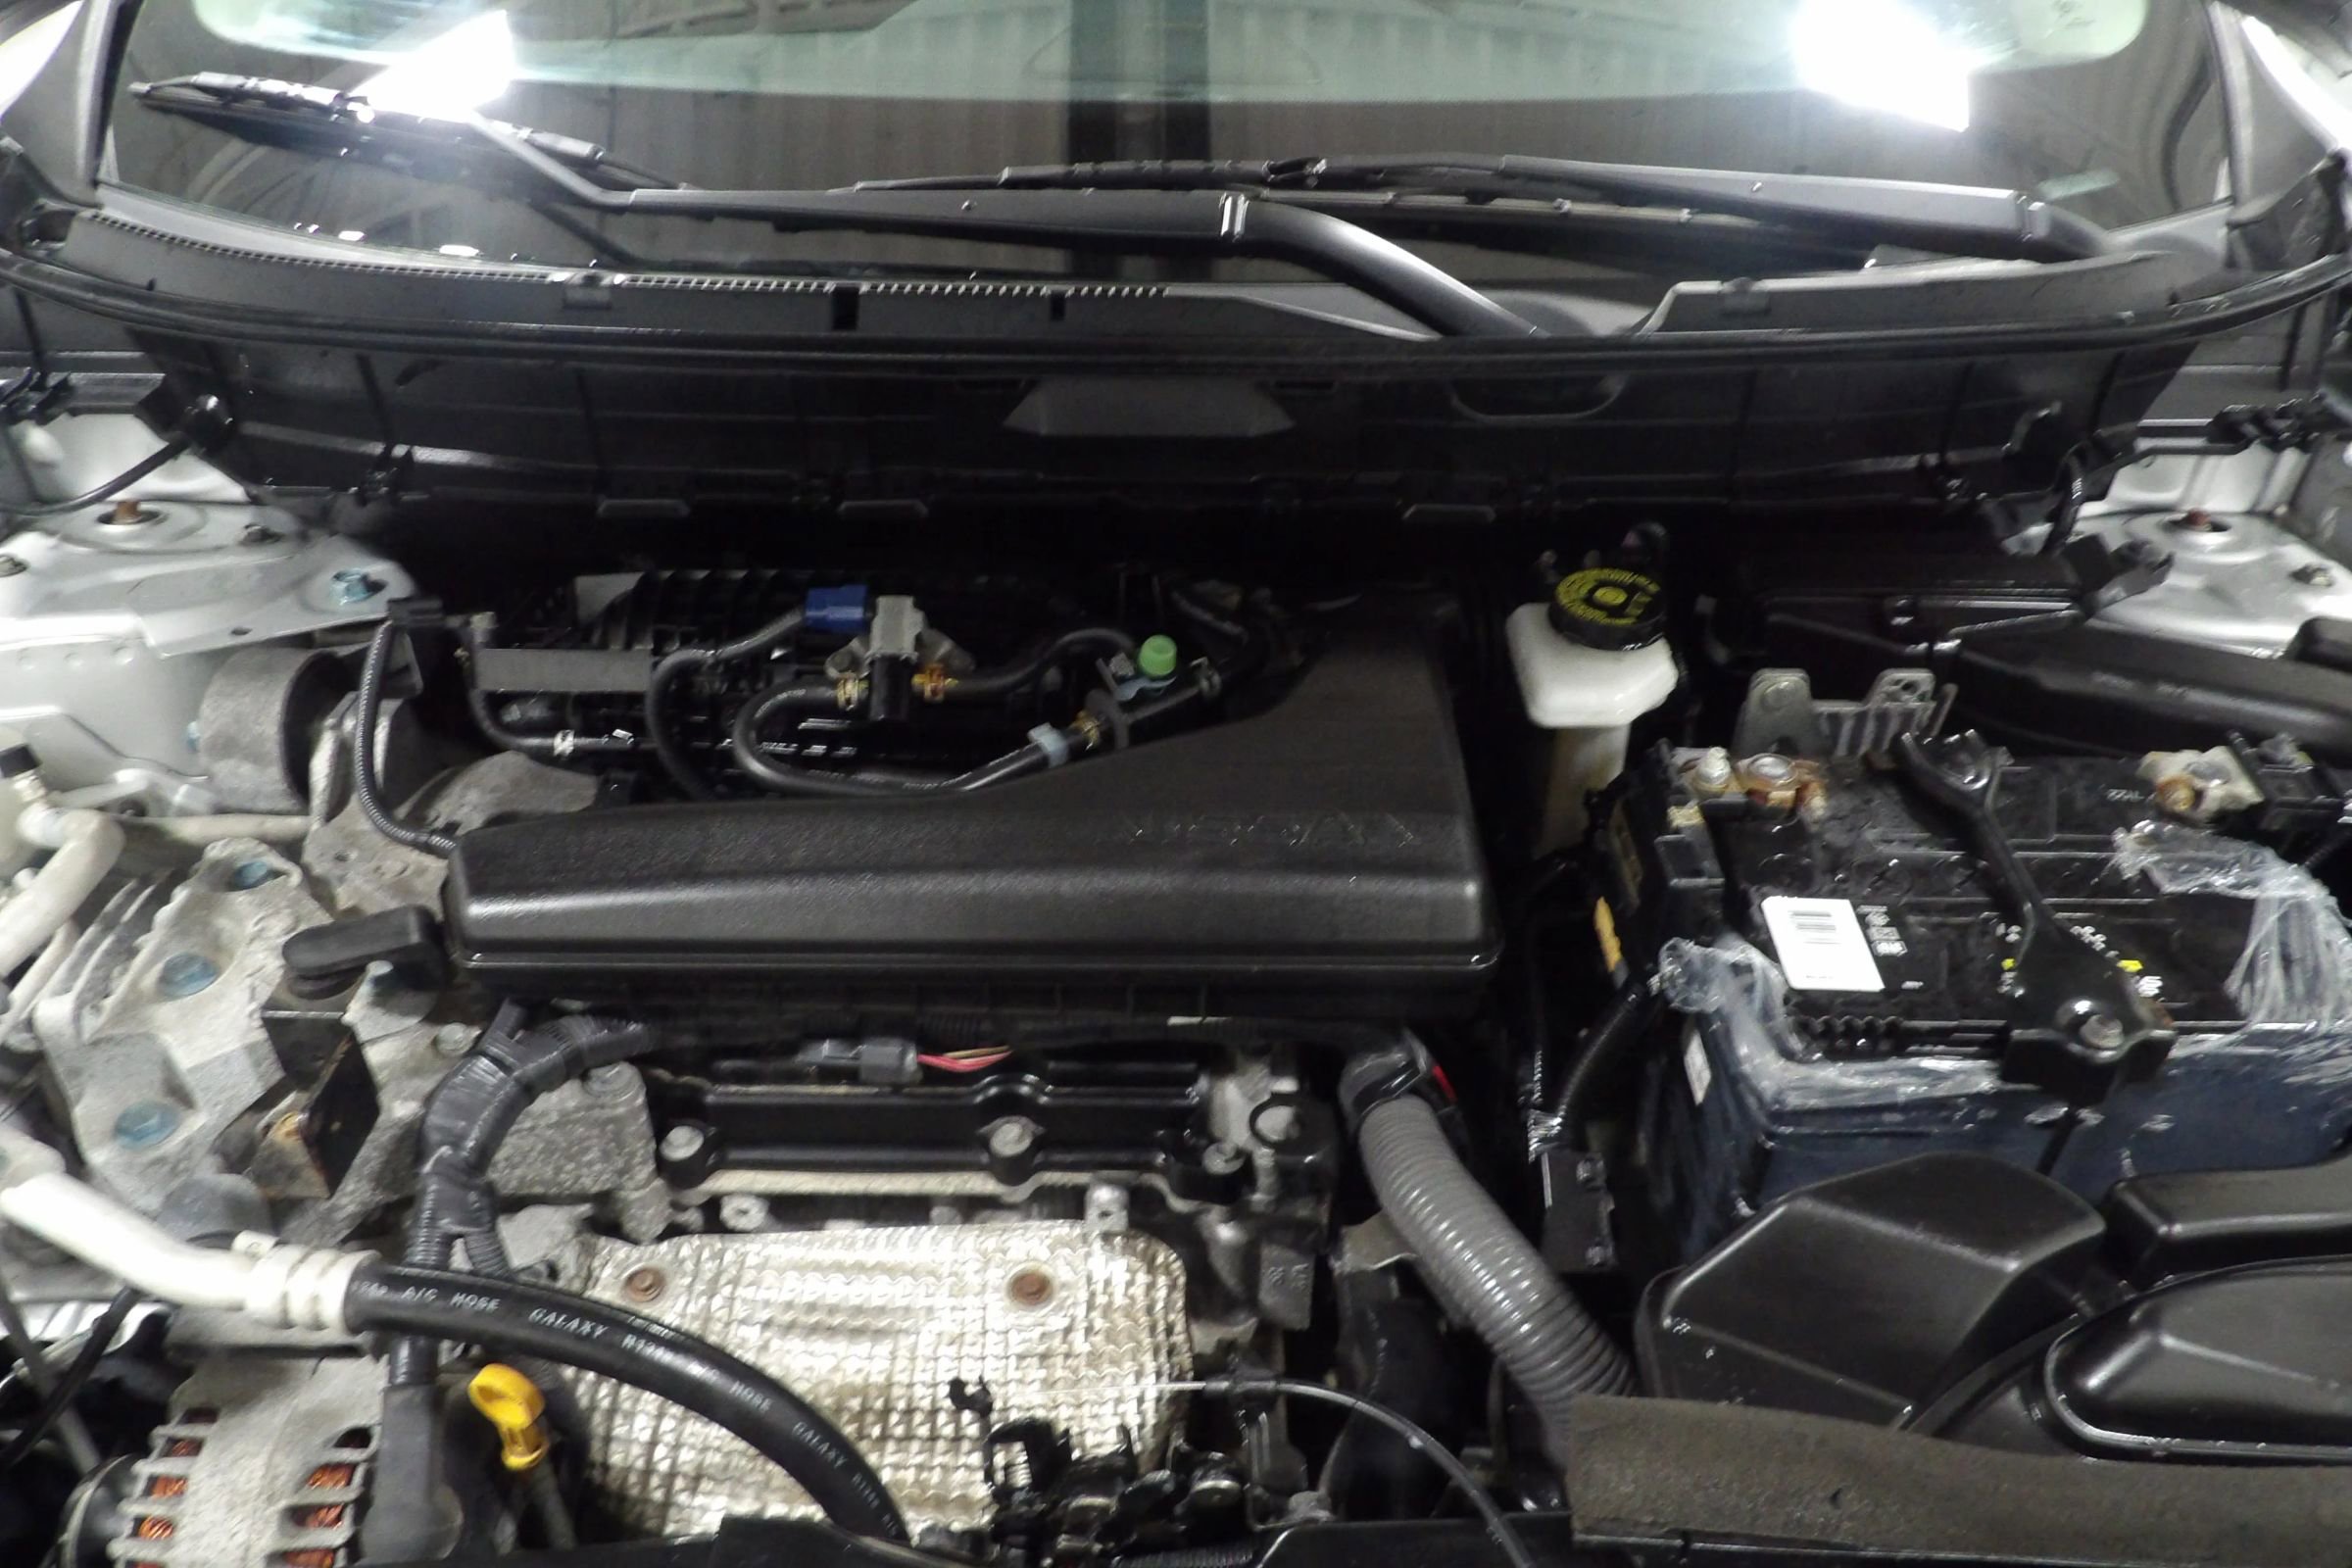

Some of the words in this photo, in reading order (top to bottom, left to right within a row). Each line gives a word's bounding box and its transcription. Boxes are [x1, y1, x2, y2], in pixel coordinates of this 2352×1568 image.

[450, 1292, 501, 1313] HOSE
[527, 1307, 610, 1340] GALAXY
[728, 1380, 772, 1413] HOSE
[792, 1421, 848, 1469] GALAXY
